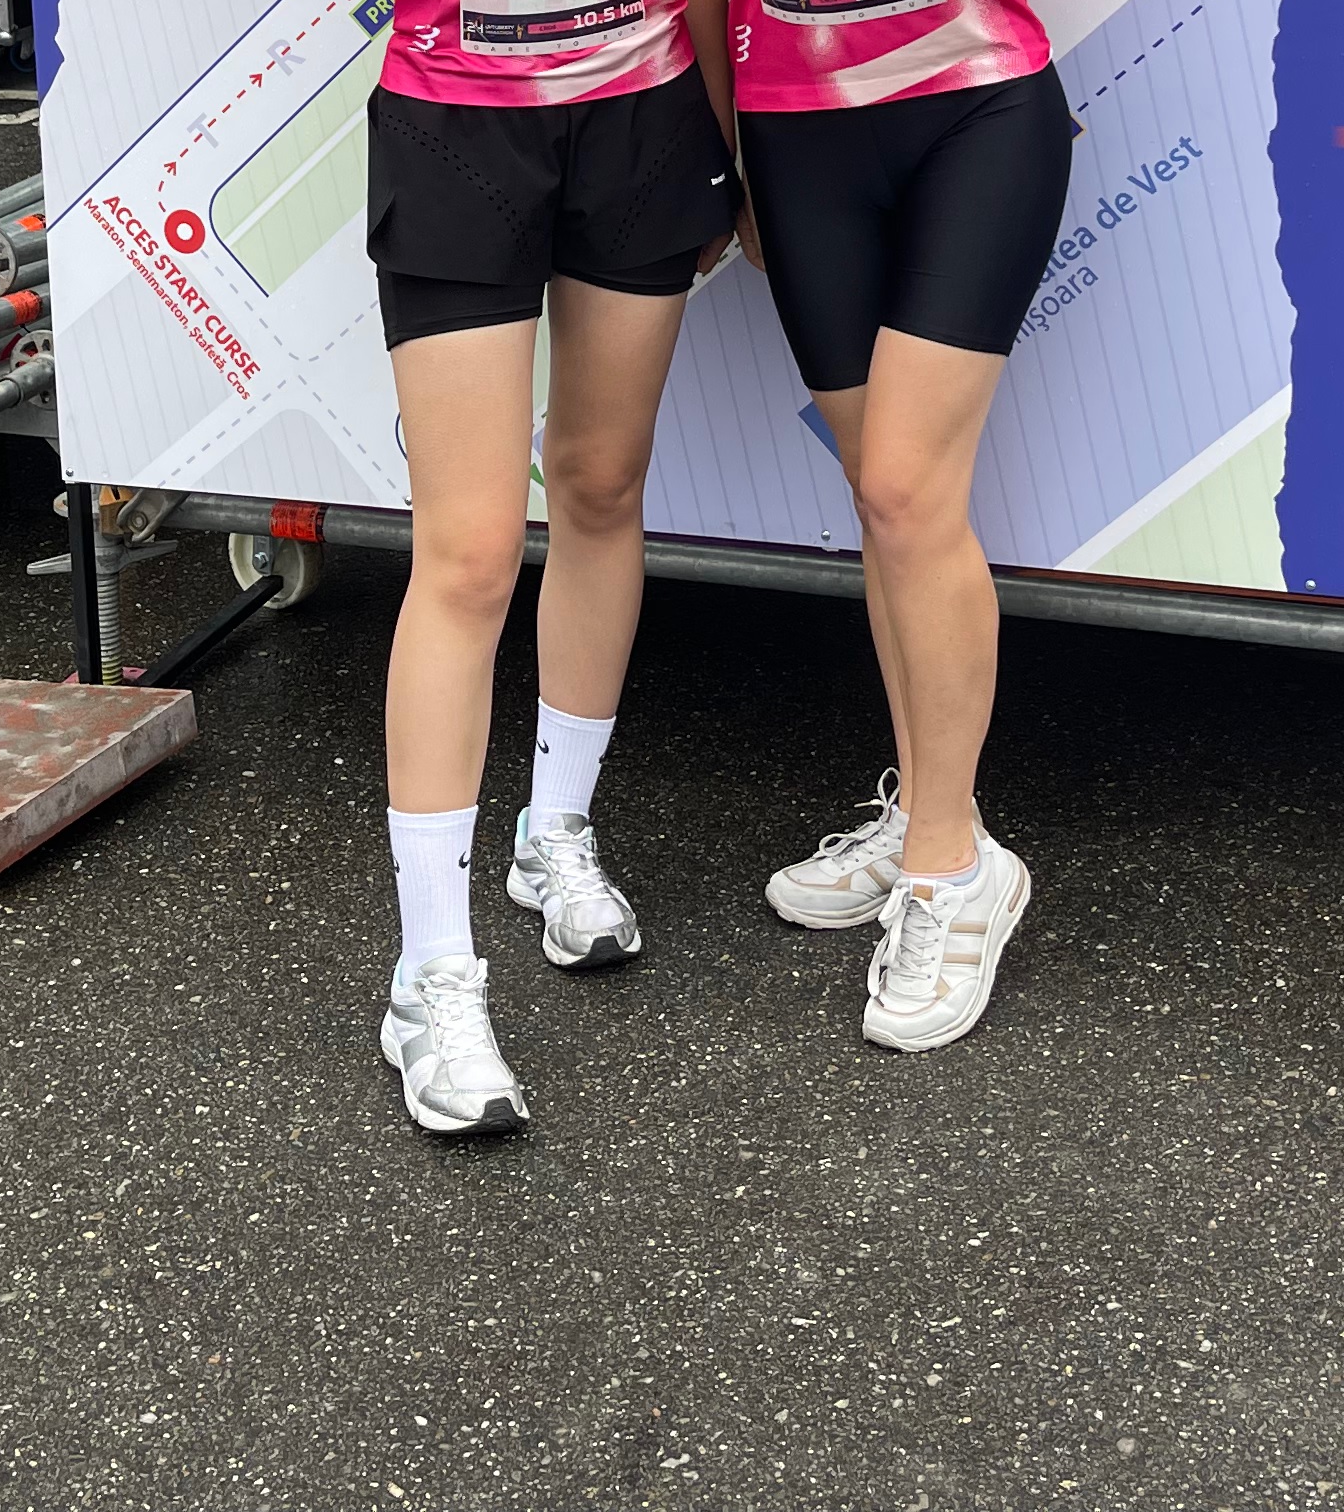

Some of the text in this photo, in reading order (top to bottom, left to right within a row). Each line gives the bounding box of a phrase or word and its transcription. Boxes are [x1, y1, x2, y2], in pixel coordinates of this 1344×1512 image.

[573, 1, 644, 29] 10.5 km
[1096, 134, 1204, 230] de Vest
[83, 197, 126, 252] Maraton,
[126, 249, 190, 330] Semimaraton,
[227, 370, 251, 401] Cros
[102, 195, 261, 380] ACCES START CURSE
